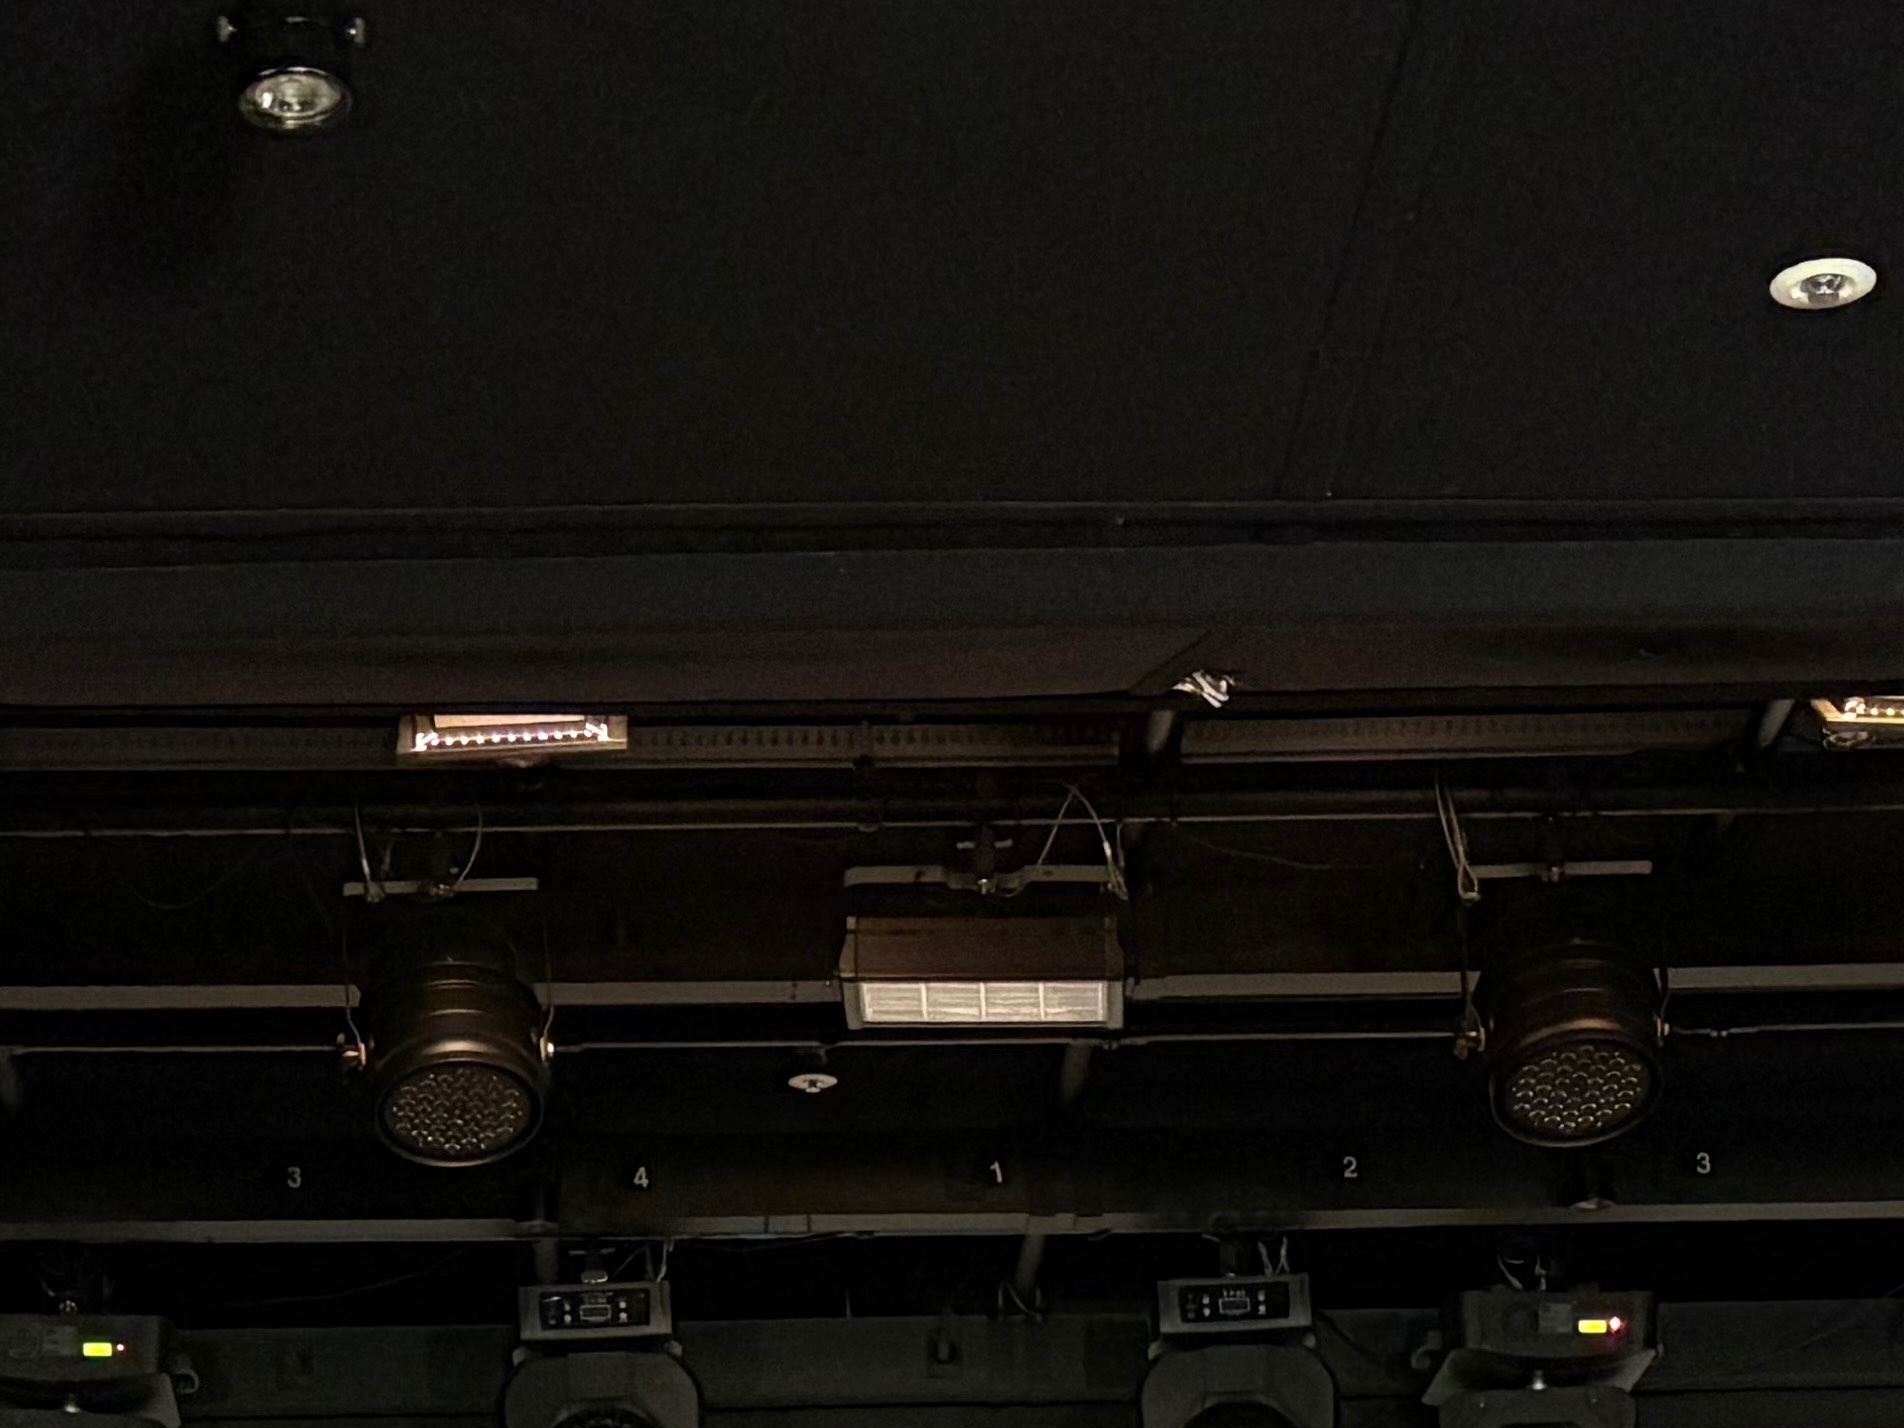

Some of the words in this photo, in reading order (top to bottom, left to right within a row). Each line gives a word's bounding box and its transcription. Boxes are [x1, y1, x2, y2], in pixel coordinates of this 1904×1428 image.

[990, 1161, 1003, 1183] 1
[1343, 1156, 1358, 1178] 2
[1696, 1151, 1711, 1174] 3
[287, 1166, 302, 1189] 3
[633, 1166, 649, 1188] 4
